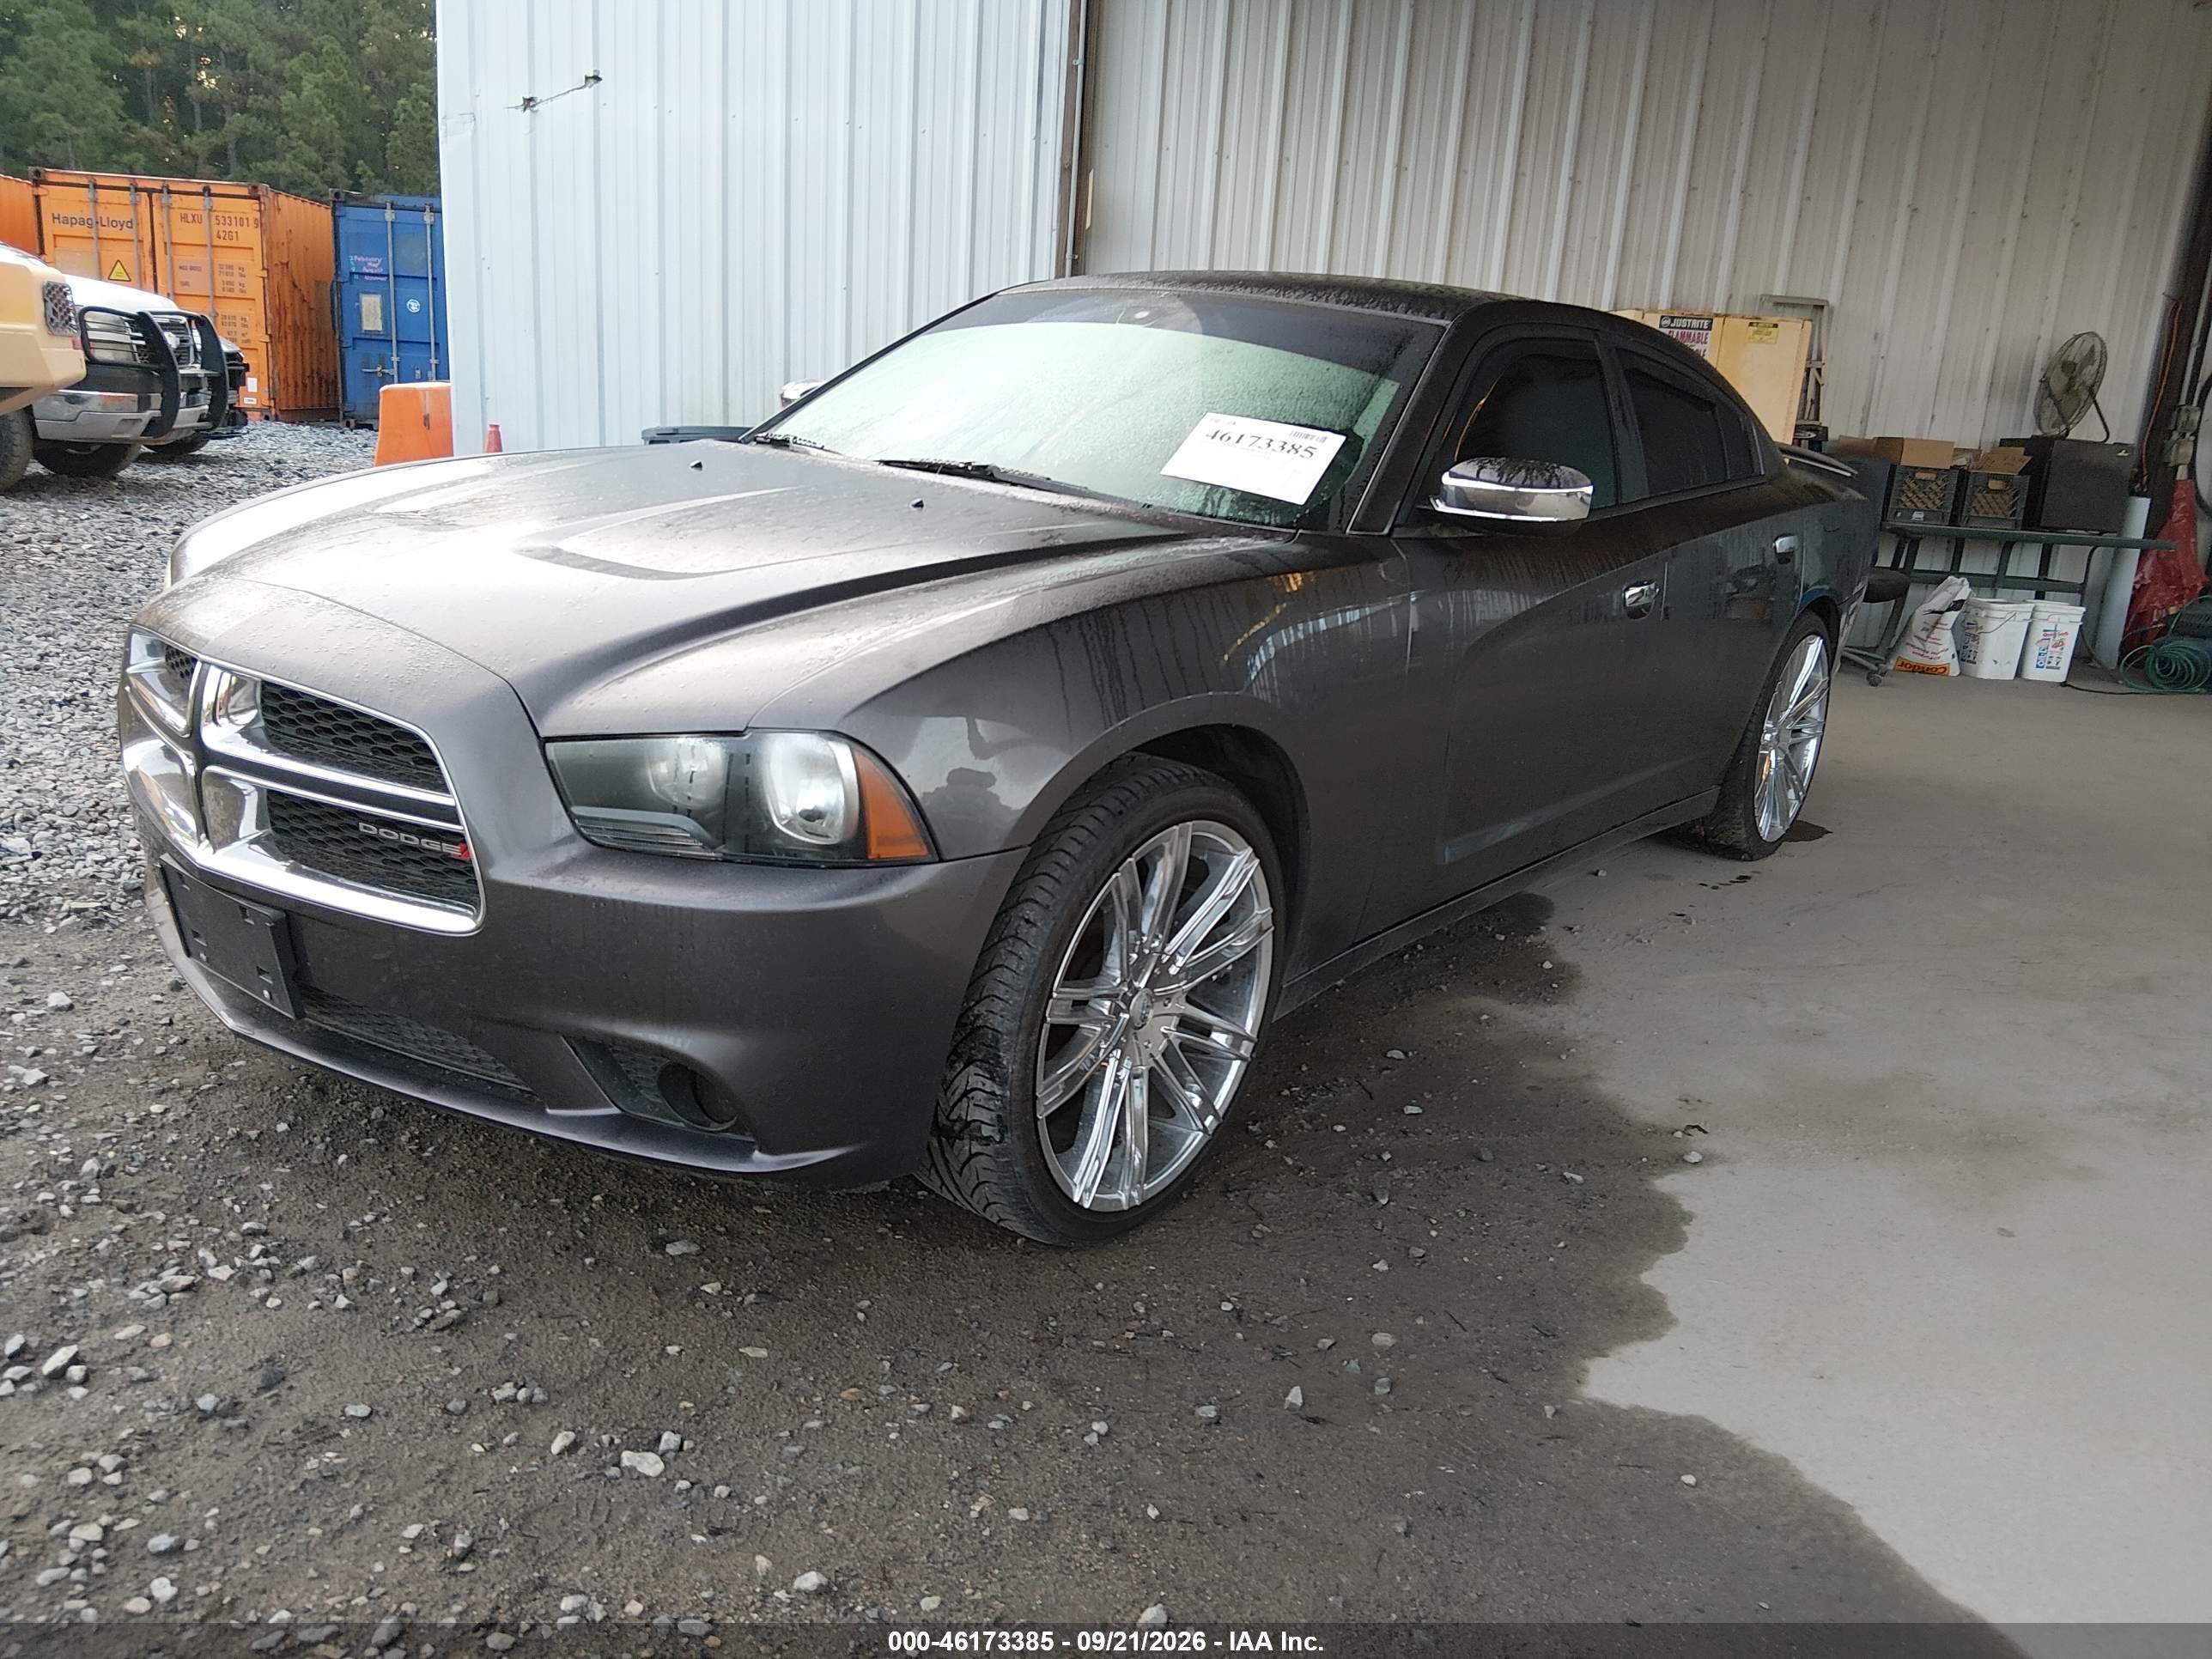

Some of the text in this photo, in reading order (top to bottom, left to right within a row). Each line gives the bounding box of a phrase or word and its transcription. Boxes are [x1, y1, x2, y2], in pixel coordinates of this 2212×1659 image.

[52, 212, 133, 230] Hapag-Lloyd
[180, 213, 203, 224] HLXU
[215, 215, 250, 228] 533101
[216, 229, 239, 241] 42G1
[1670, 317, 1709, 329] JUSTRITE
[1206, 429, 1317, 459] 46173385
[1897, 660, 1948, 674] Condor
[359, 822, 462, 856] DODGE
